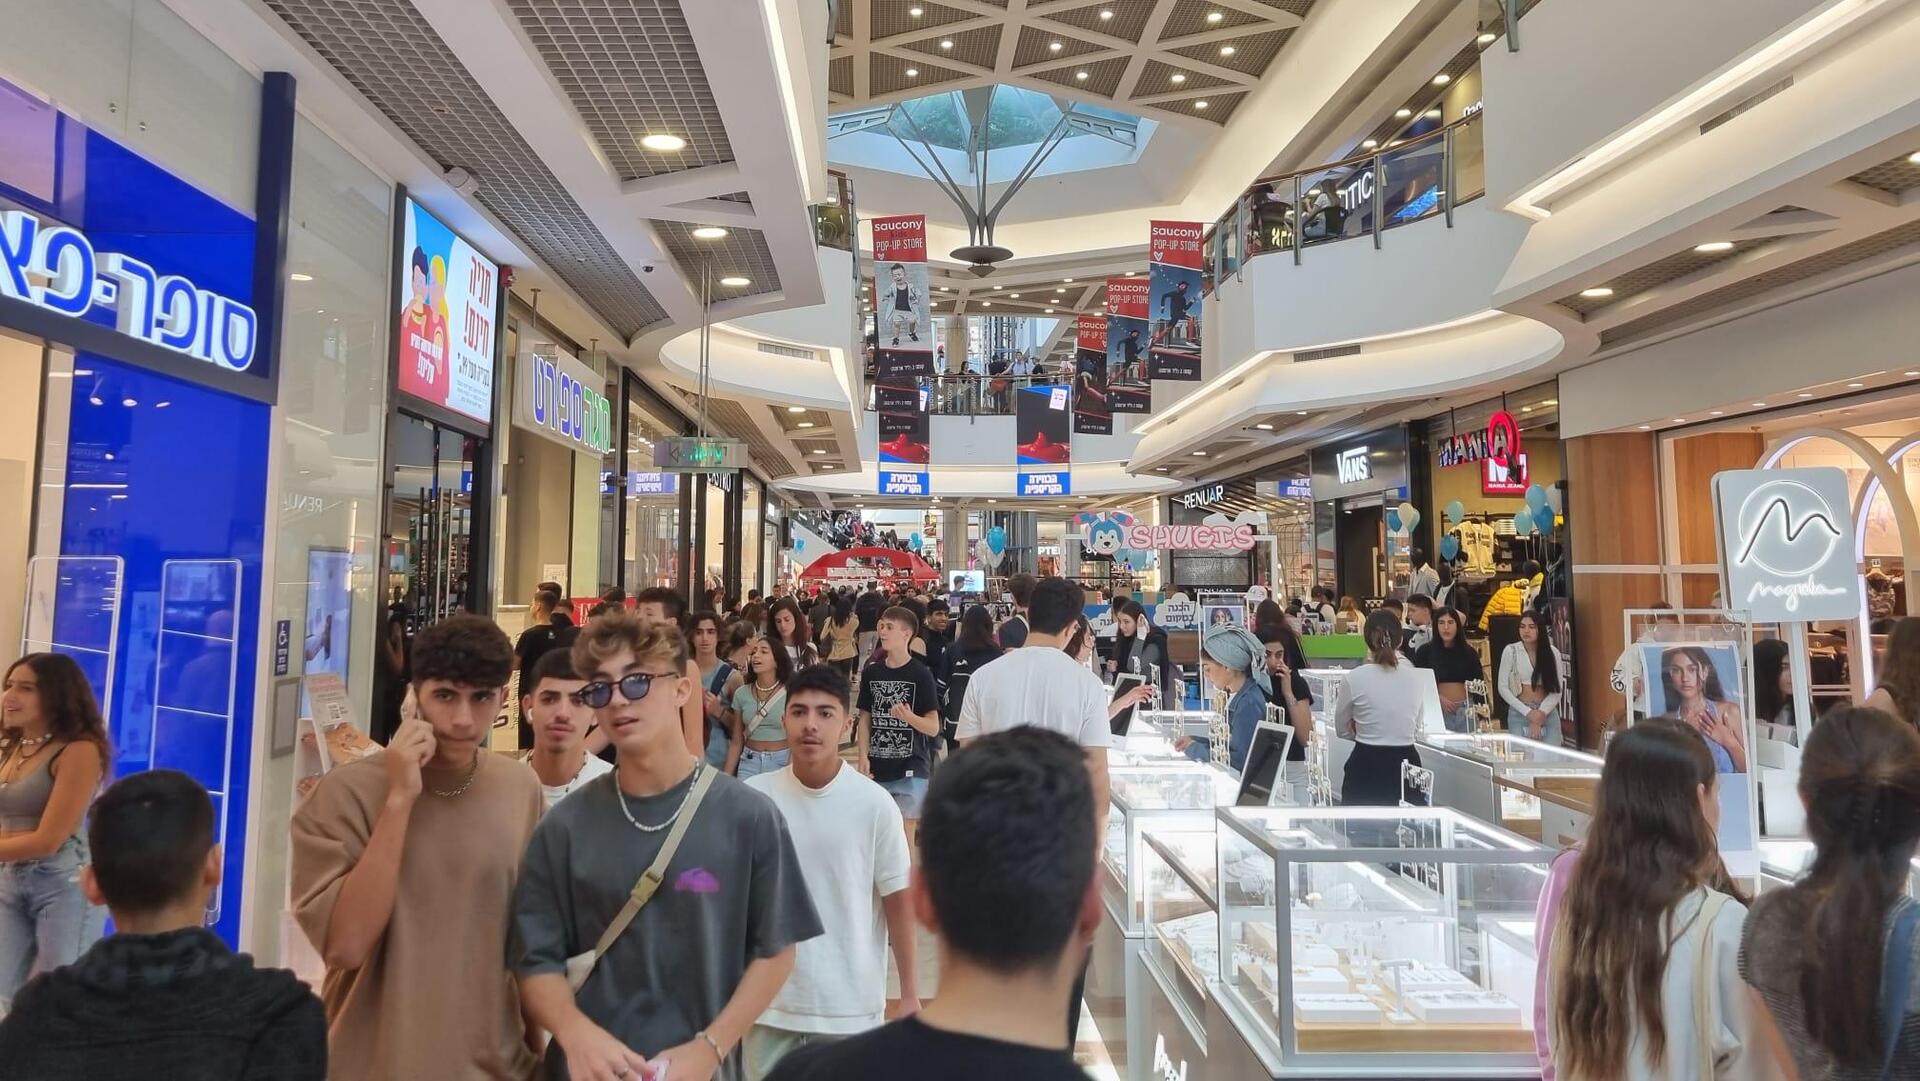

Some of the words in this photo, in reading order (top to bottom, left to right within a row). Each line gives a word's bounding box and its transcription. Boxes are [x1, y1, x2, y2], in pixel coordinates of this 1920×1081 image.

[874, 221, 923, 232] saucony
[1152, 227, 1201, 239] saucony
[876, 240, 901, 252] POP-UP
[903, 237, 923, 250] STORE
[1153, 239, 1177, 250] POP-UP
[1180, 240, 1200, 252] STORE
[469, 255, 491, 309] חניה
[1108, 284, 1150, 293] saucony
[1109, 295, 1131, 304] POP-UP
[1079, 322, 1107, 330] sauco
[1336, 446, 1369, 485] VANS
[1184, 485, 1224, 509] RENUAR
[1128, 524, 1256, 550] SHUGIS
